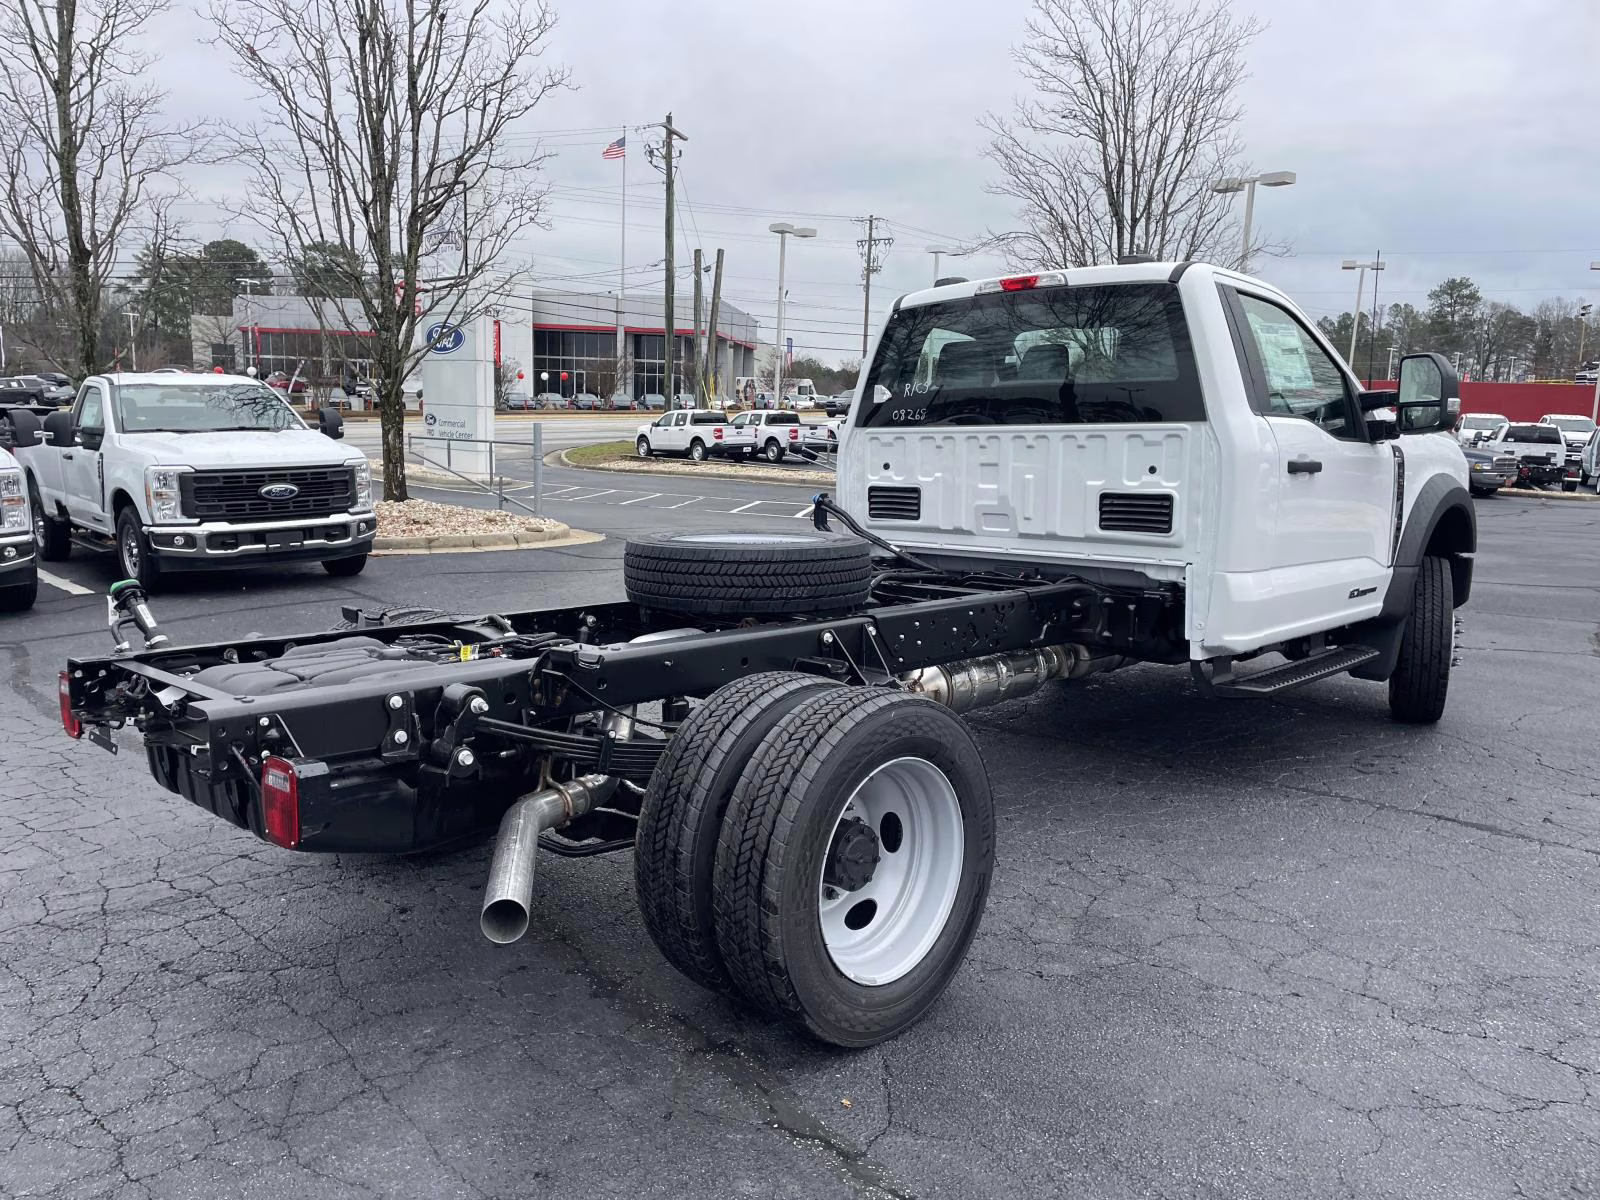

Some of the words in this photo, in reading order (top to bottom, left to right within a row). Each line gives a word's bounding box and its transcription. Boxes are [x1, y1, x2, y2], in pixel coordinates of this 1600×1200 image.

[892, 408, 927, 420] 08268
[438, 418, 465, 428] Commercial
[438, 429, 454, 438] Vehicle
[455, 430, 473, 439] Center
